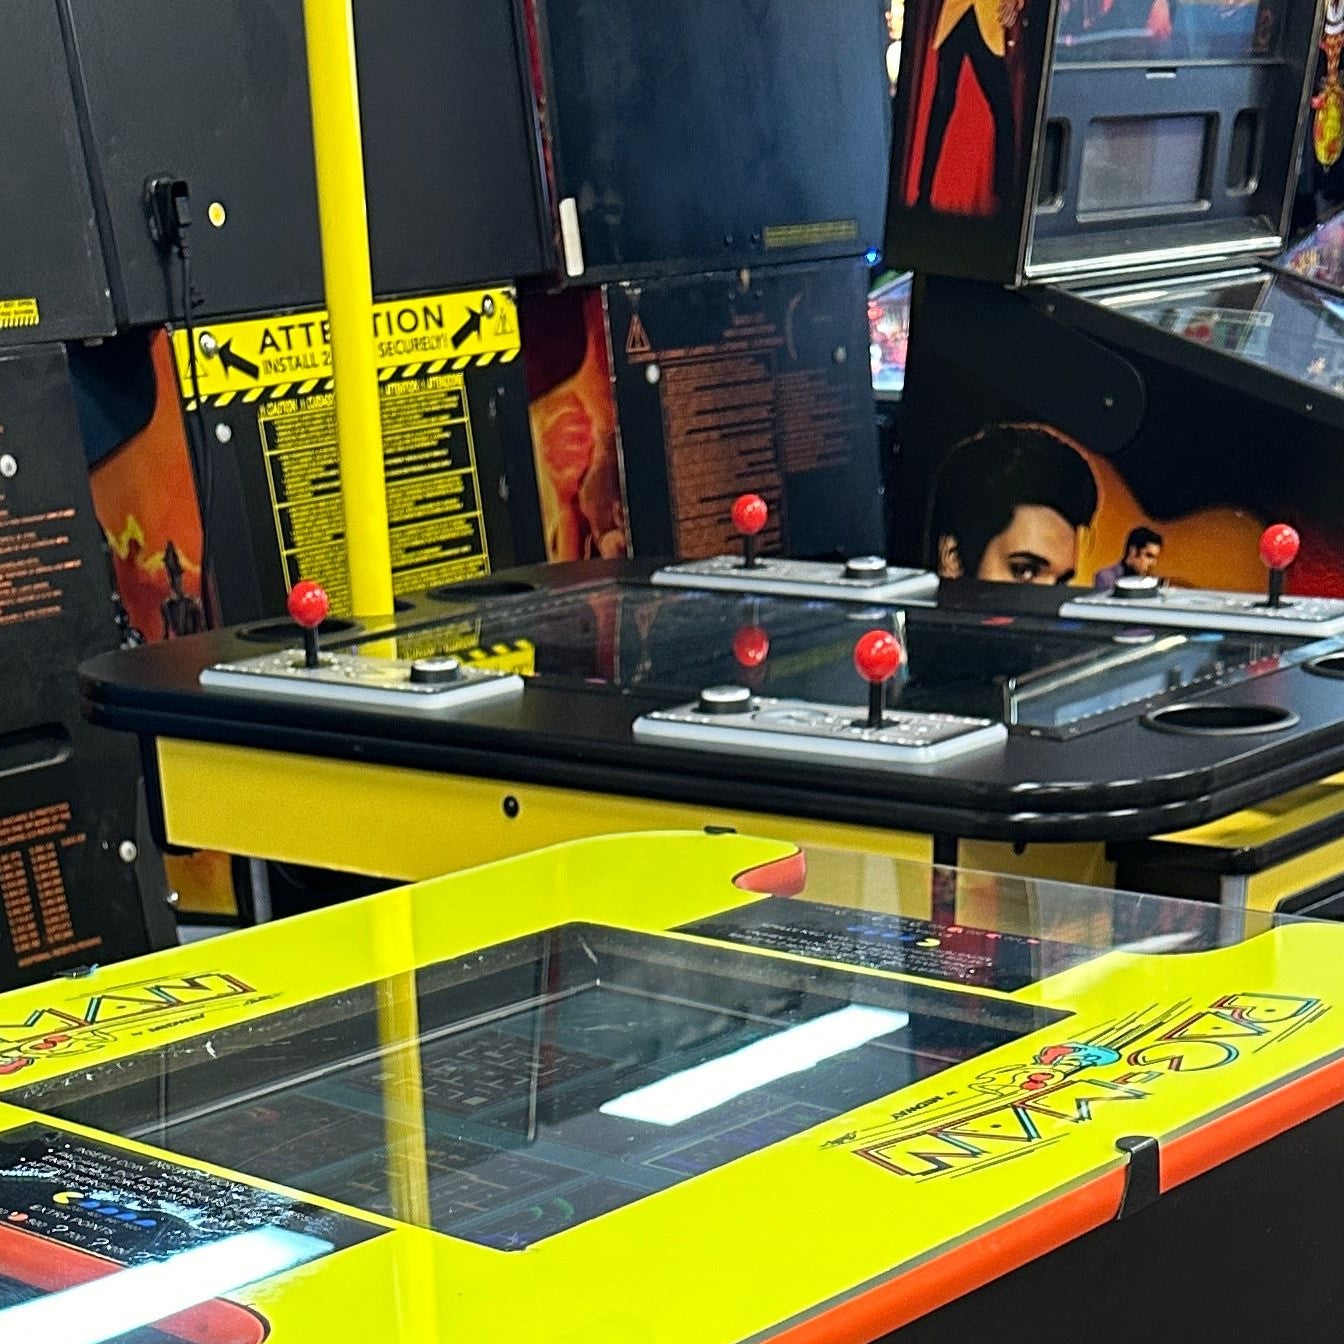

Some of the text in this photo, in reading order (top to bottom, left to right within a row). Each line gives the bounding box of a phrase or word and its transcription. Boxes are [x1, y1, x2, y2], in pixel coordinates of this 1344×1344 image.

[259, 304, 444, 355] ATTETION
[262, 351, 318, 375] INSTALL
[853, 992, 1321, 1177] PAC-MAN
